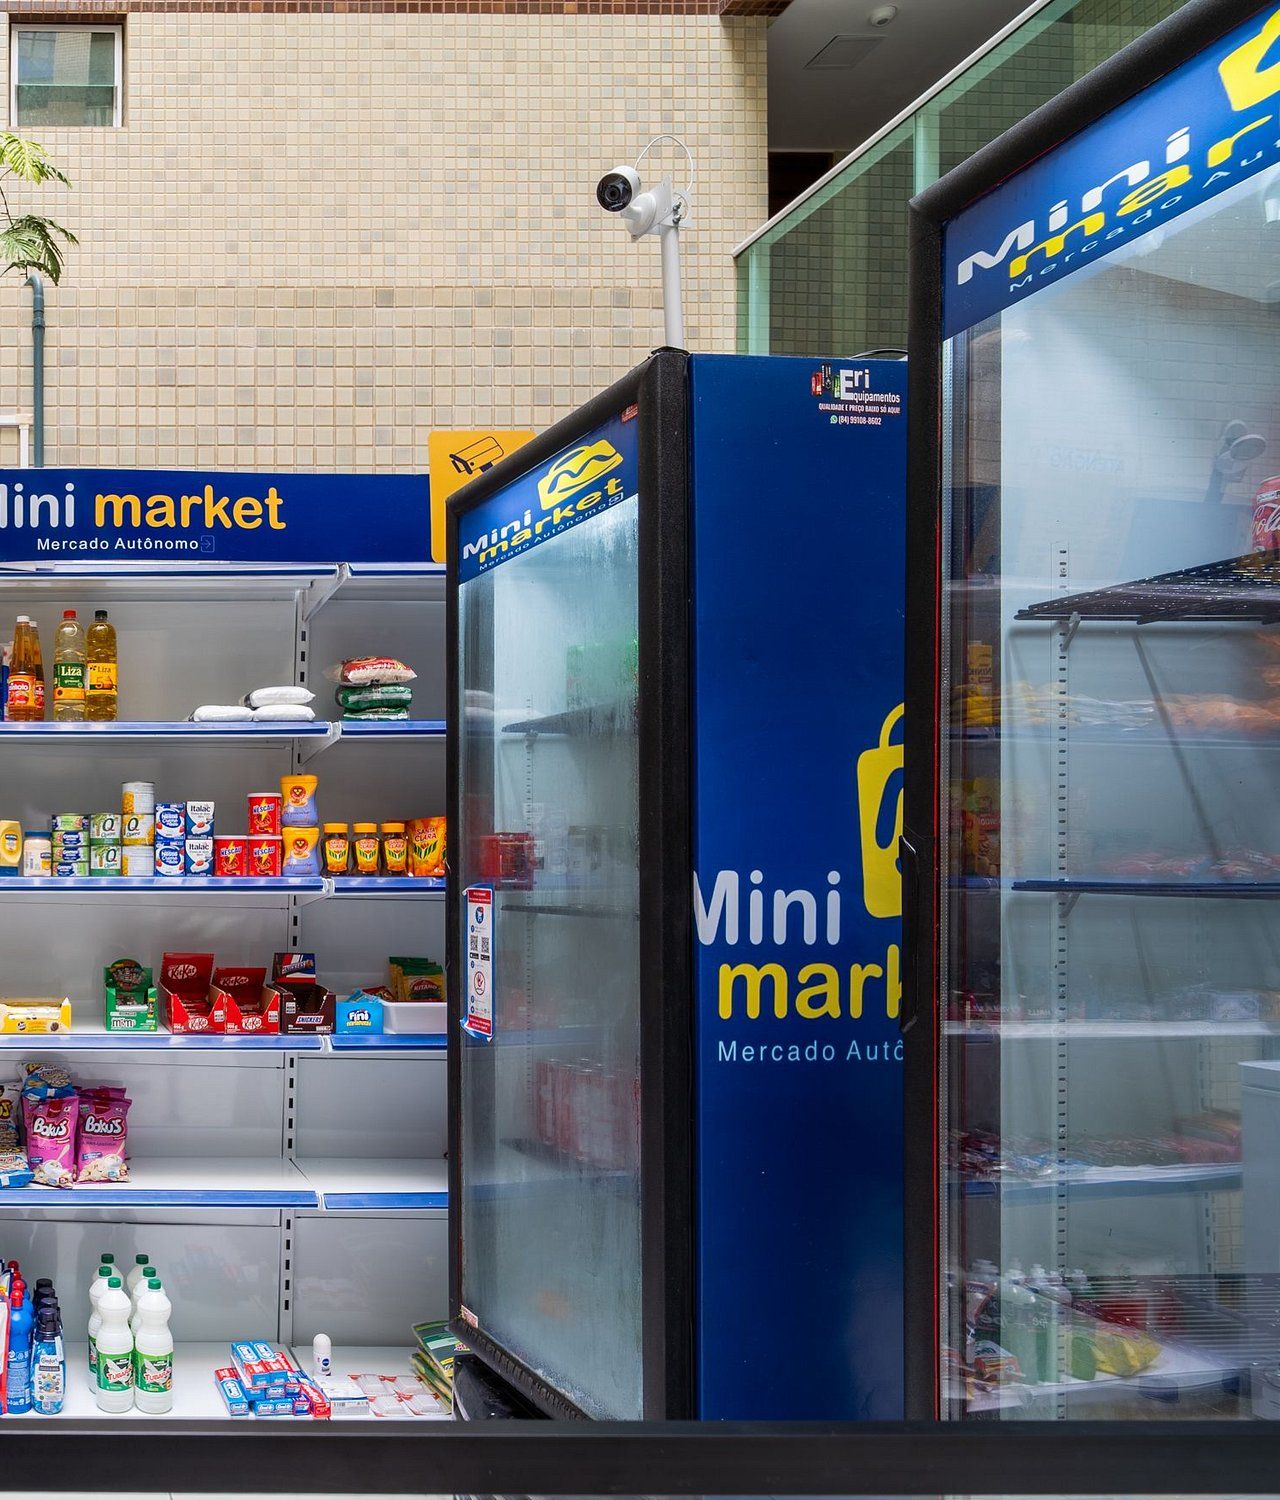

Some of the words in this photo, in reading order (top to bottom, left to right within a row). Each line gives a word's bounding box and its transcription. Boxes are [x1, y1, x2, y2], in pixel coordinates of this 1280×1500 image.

[958, 126, 1190, 285] Mini
[1010, 195, 1182, 292] Mercado
[818, 402, 844, 410] QUALIDADE
[94, 484, 287, 530] market
[479, 477, 623, 564] market
[37, 537, 110, 550] Mercado
[114, 536, 199, 550] Autônomo
[463, 510, 531, 560] Mini
[480, 542, 530, 572] Mercado
[61, 666, 82, 676] Liza
[253, 803, 275, 814] NESCAU
[220, 846, 242, 856] NESCAU
[253, 846, 275, 856] NESCAU
[693, 870, 841, 945] Mini
[718, 1040, 835, 1062] Mercado
